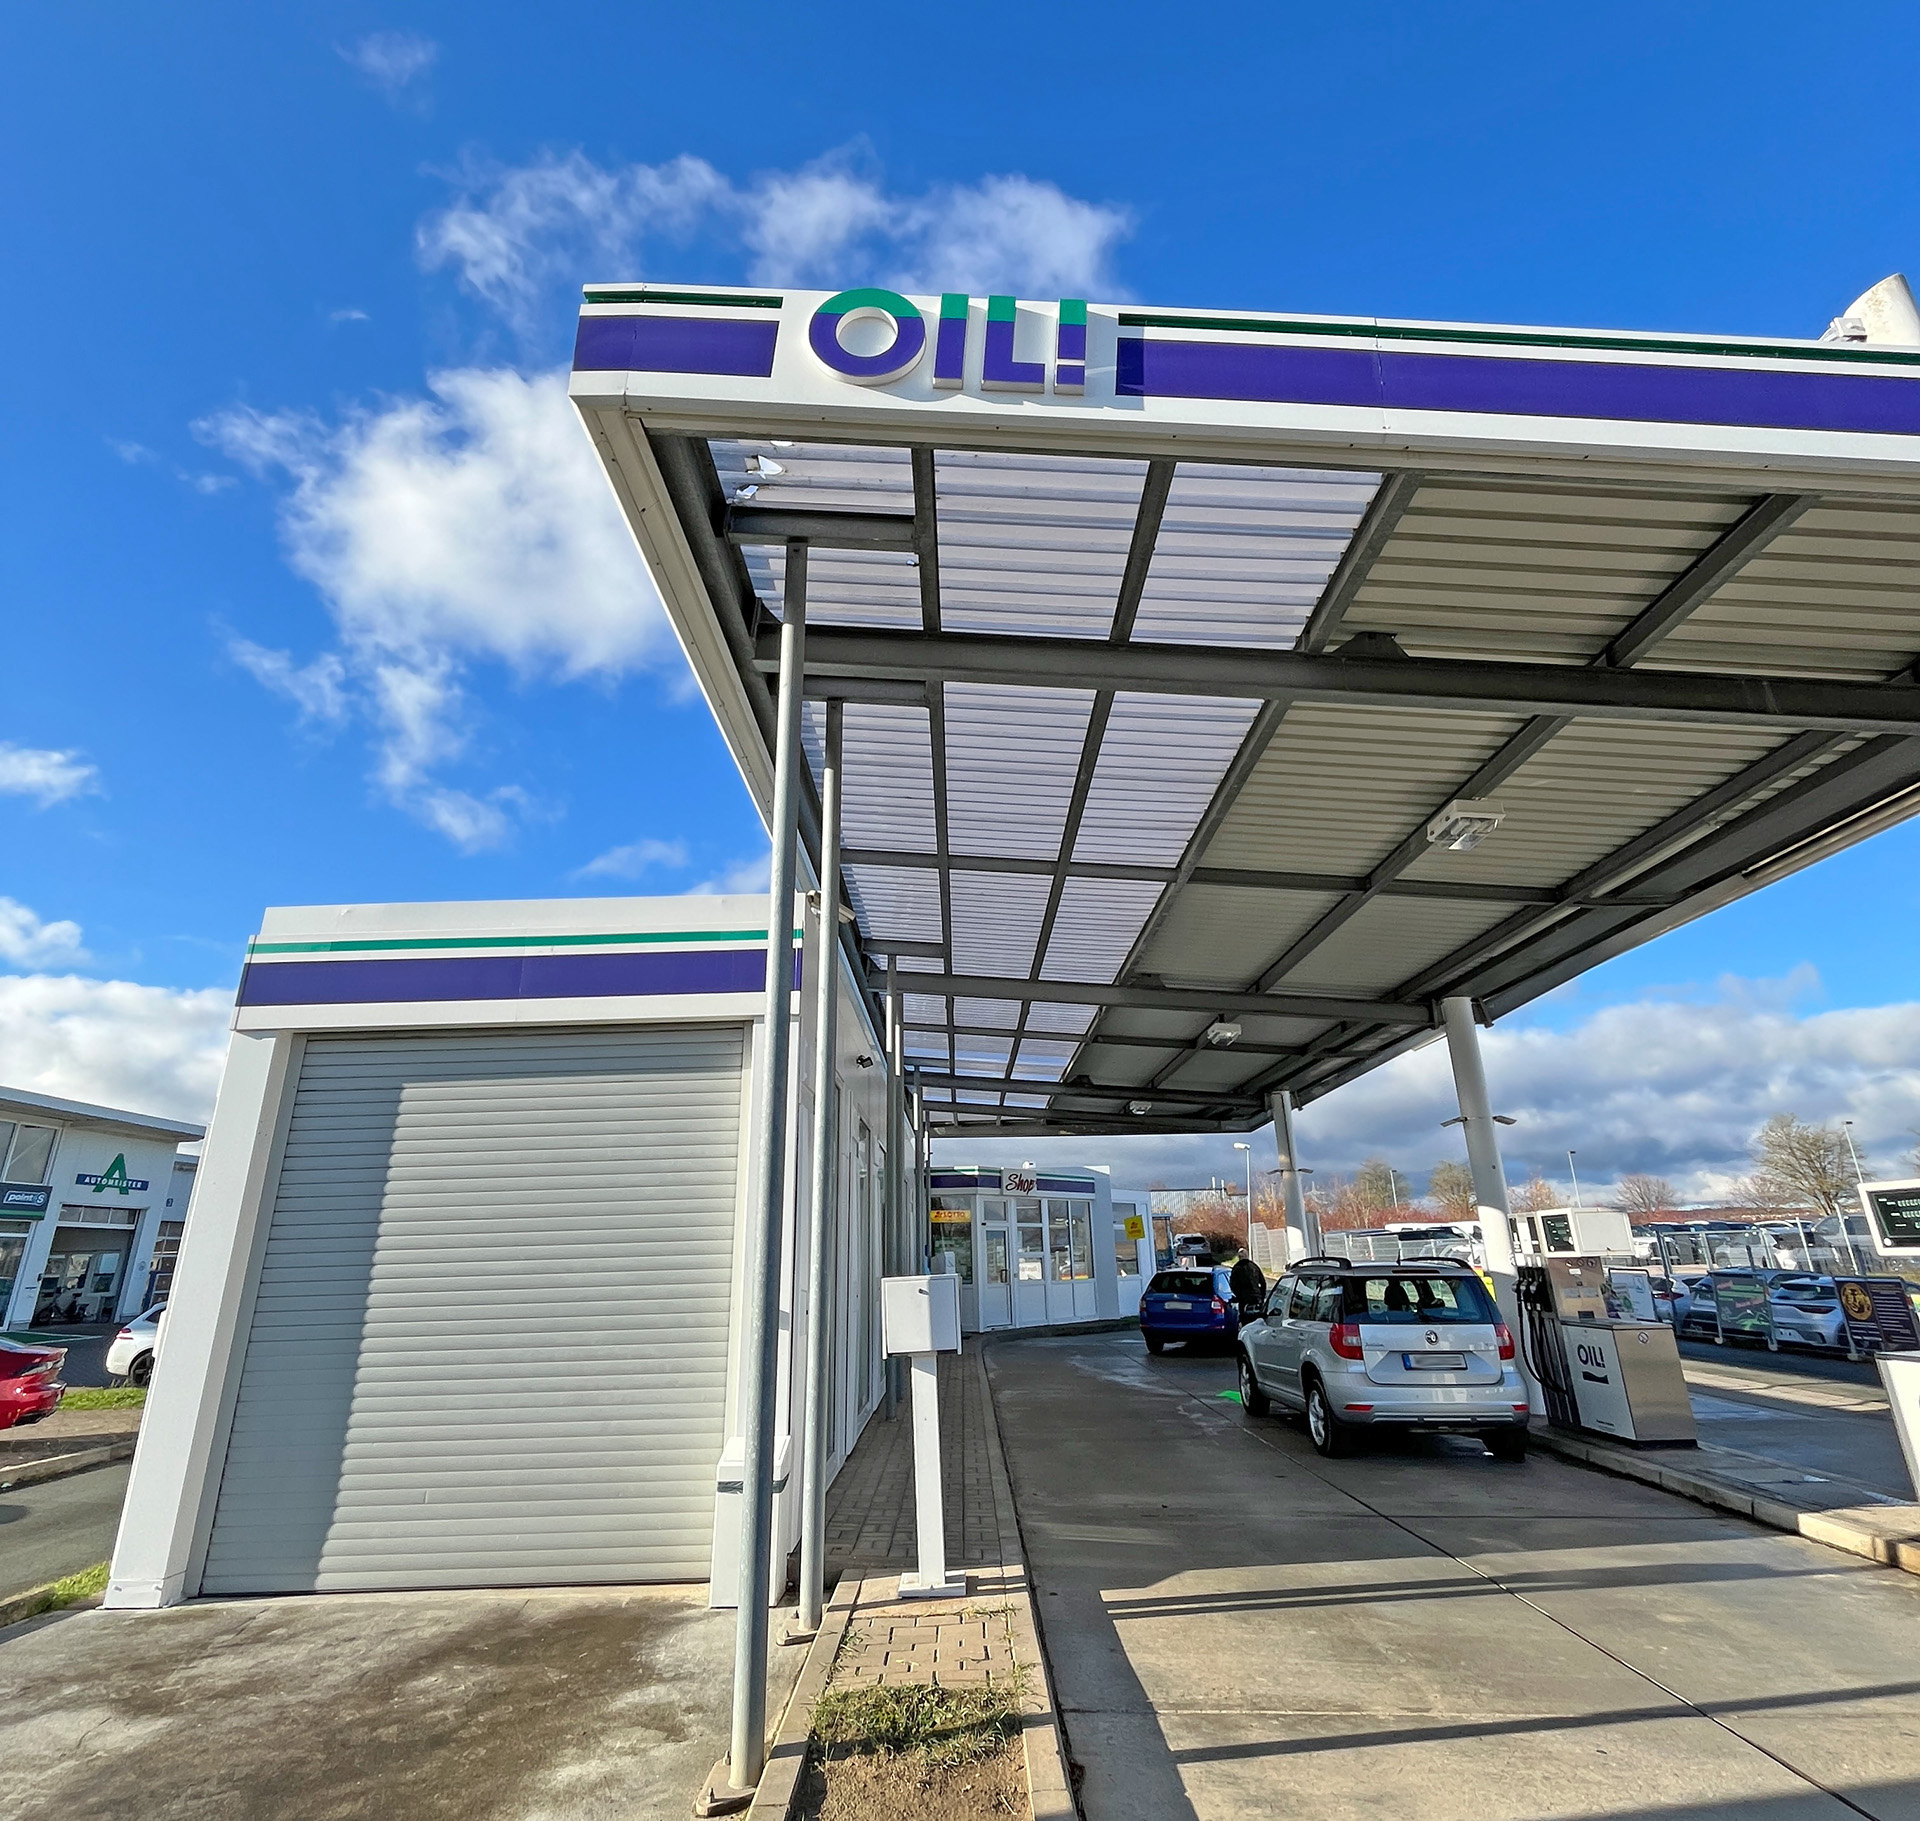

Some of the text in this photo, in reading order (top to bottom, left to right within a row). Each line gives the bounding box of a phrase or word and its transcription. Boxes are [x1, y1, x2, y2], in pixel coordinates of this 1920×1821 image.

[808, 287, 1087, 390] OIL!
[84, 1175, 143, 1189] AUTOMEISTER
[1005, 1173, 1036, 1195] Shop
[1577, 1343, 1606, 1369] OIL!
